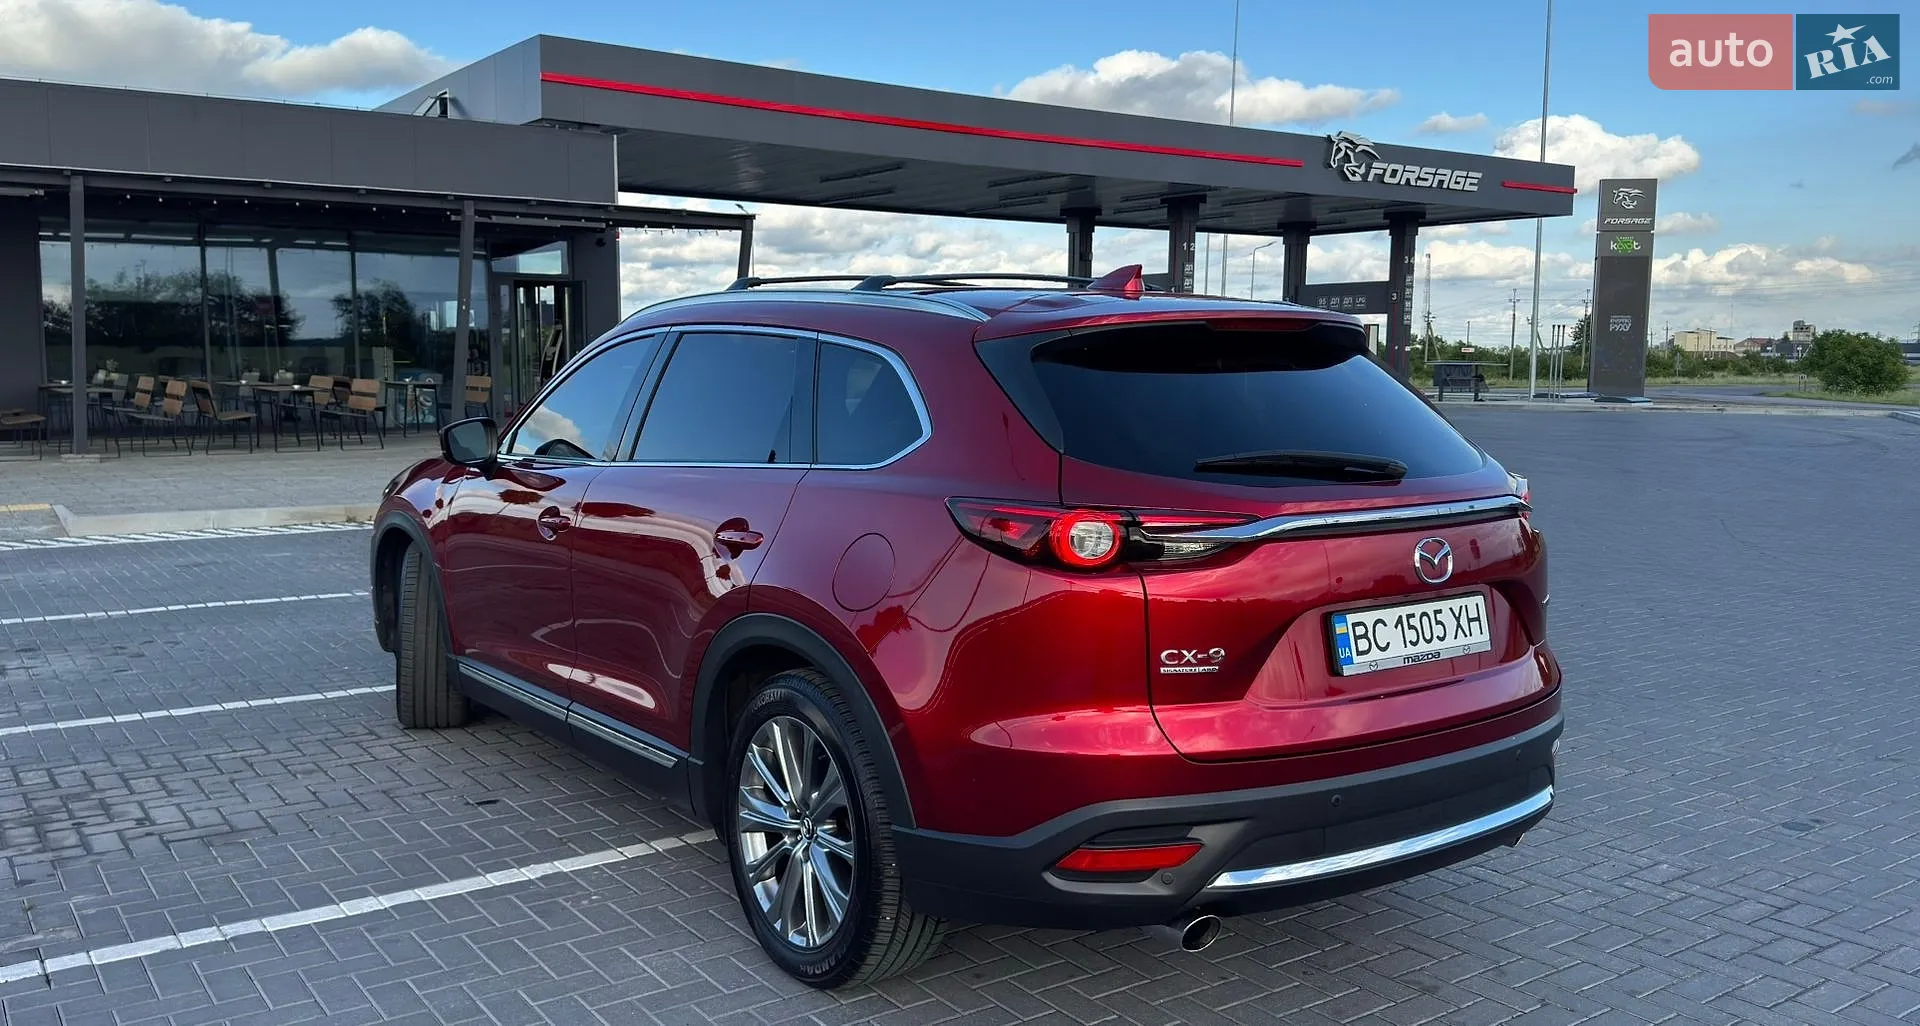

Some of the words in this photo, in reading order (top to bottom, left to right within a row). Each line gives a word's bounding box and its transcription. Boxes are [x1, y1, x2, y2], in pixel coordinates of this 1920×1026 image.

[1367, 161, 1483, 192] FORSAGE
[1604, 217, 1652, 225] FORSAGE
[1352, 618, 1391, 656] BC
[1394, 608, 1447, 648] 1505
[1449, 602, 1484, 640] XH
[1160, 647, 1225, 665] CX-9
[1339, 647, 1351, 659] UA
